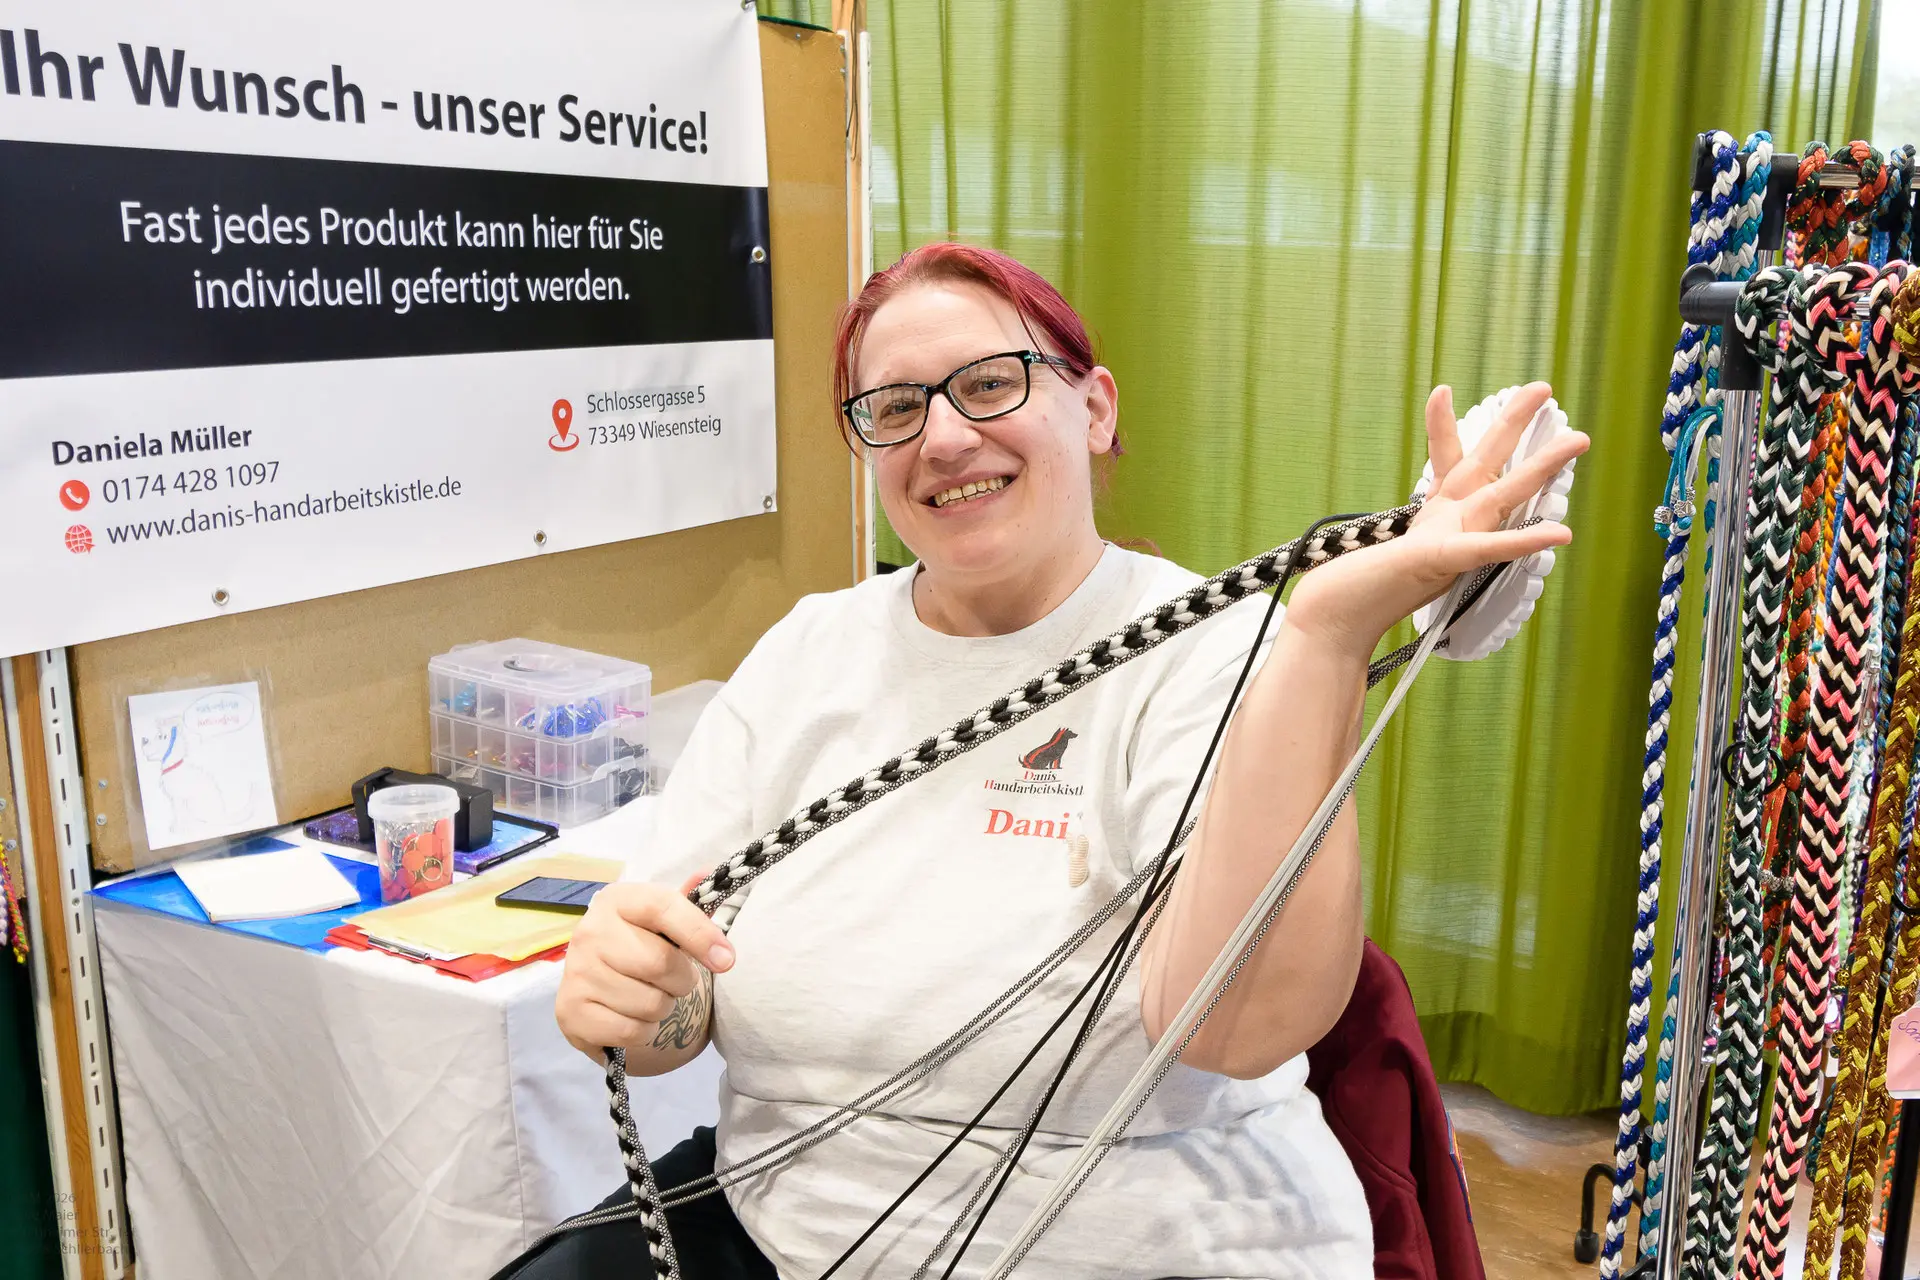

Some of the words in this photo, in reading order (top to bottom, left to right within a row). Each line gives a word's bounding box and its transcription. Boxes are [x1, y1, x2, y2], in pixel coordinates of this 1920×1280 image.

[0, 29, 104, 101] Ihr
[118, 43, 365, 123] Wunsch
[381, 101, 397, 110] -
[414, 91, 545, 139] unser
[558, 94, 707, 154] Service!
[121, 201, 202, 243] Fast
[211, 204, 310, 254] jedes
[320, 208, 447, 246] Produkt
[456, 211, 524, 247] kann
[533, 214, 582, 248] hier
[588, 216, 623, 249] für
[630, 219, 663, 250] Sie
[194, 268, 381, 308] individuell
[392, 267, 519, 314] gefertigt
[526, 268, 629, 301] werden.
[588, 388, 694, 414] Schlossergasse
[697, 385, 706, 404] 5
[52, 433, 162, 465] Daniela
[171, 426, 252, 454] Müller
[589, 424, 635, 445] 73349
[639, 415, 721, 439] Wiesensteig
[103, 474, 166, 503] 0174
[173, 468, 217, 493] 428
[226, 461, 279, 487] 1097
[107, 476, 461, 544] www.danis-handarbeitskistle.de
[984, 779, 1085, 796] Handarbeitskistl
[1024, 770, 1058, 781] Danis
[984, 808, 1070, 839] Dani
